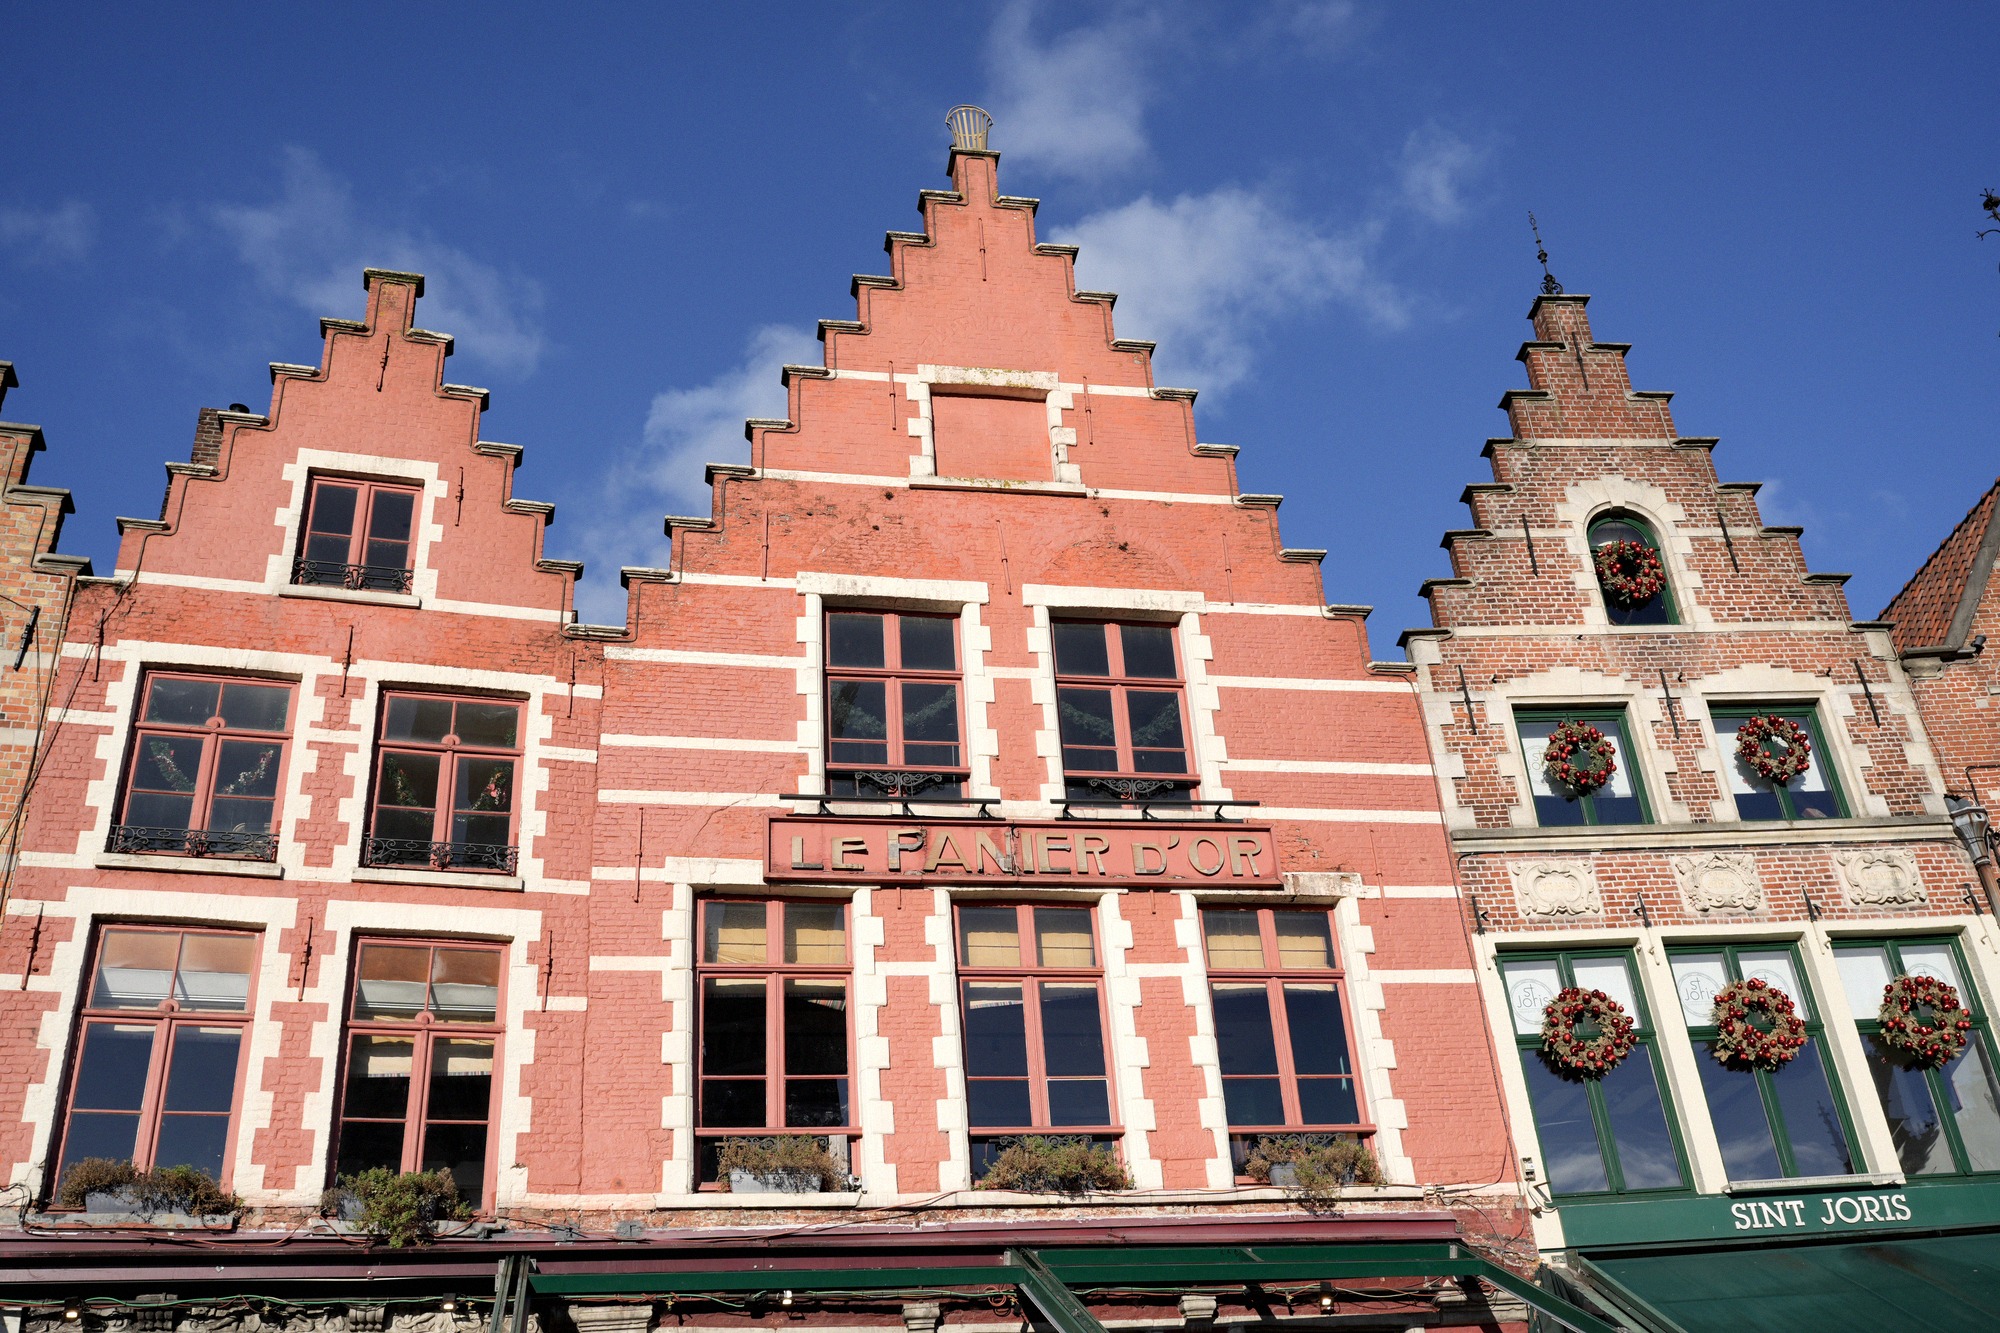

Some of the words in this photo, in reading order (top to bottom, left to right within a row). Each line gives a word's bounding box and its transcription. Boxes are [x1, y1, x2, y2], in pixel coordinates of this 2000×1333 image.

[792, 835, 867, 871] LE
[887, 829, 1110, 875] PANIER
[1131, 834, 1263, 877] D'OR
[1730, 1199, 1806, 1230] SINT
[1820, 1193, 1912, 1226] JORIS
